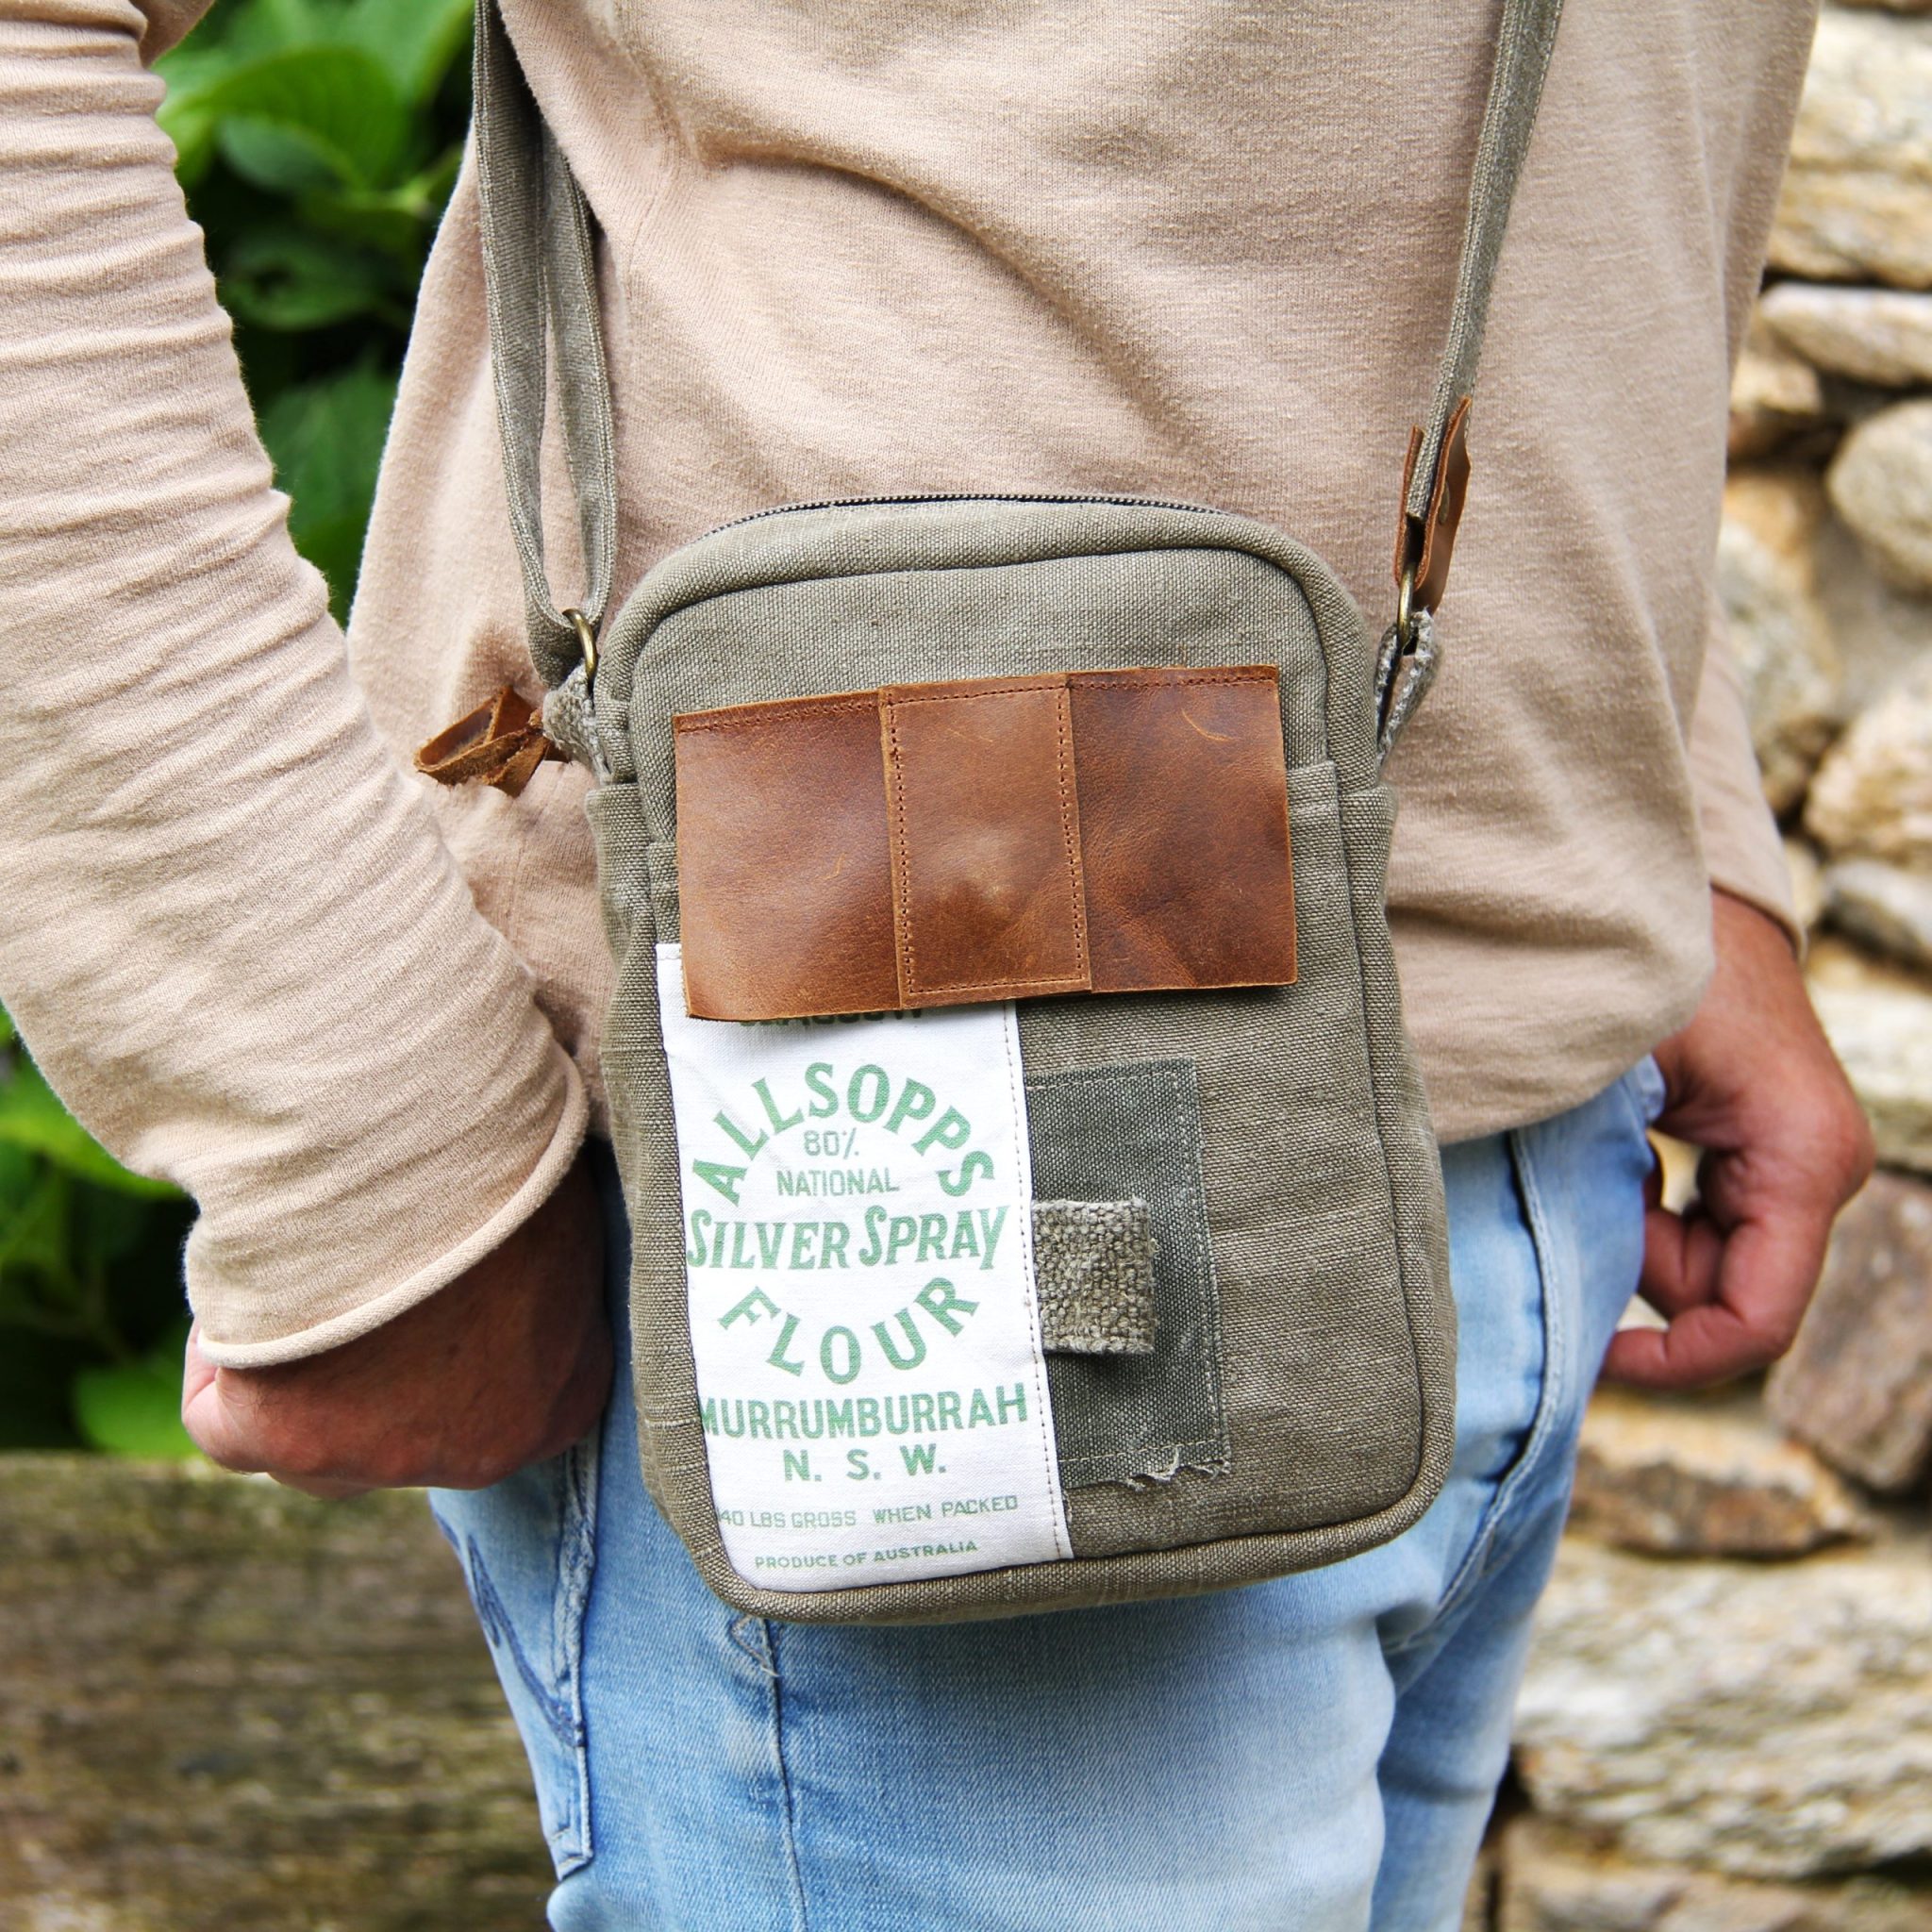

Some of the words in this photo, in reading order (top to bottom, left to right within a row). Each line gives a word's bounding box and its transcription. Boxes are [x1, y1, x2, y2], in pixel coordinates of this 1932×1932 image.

[692, 1062, 995, 1206] ALLSOPPS
[776, 1169, 900, 1197] NATIONAL
[687, 1208, 850, 1270] SILVER
[858, 1205, 1008, 1271] SPRAY
[717, 1276, 981, 1385] FLOUR
[698, 1383, 1027, 1440] MURRUMBURRAH
[782, 1449, 823, 1482] N.
[846, 1448, 881, 1480] S.
[899, 1442, 947, 1477] W.
[750, 1511, 786, 1528] LBS
[791, 1509, 857, 1528] GROSS
[873, 1504, 932, 1524] WHEN
[941, 1494, 1019, 1518] PACKED
[755, 1554, 838, 1569] PRODUCE
[843, 1551, 867, 1566] OF
[873, 1540, 978, 1562] AUSTRALIA
